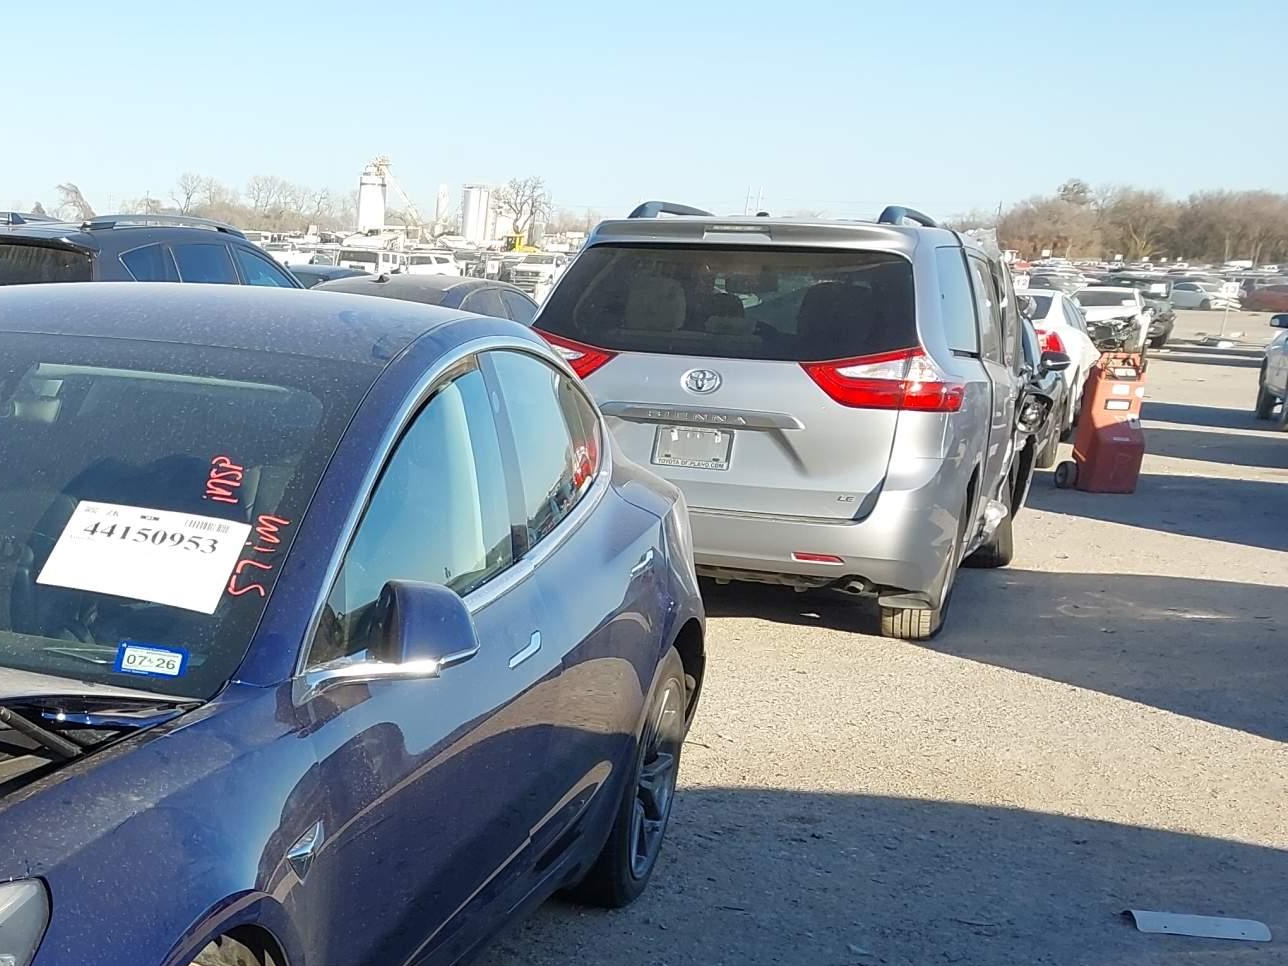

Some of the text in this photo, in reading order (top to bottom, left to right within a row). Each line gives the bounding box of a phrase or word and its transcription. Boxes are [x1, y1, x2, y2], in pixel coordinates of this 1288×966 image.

[837, 495, 855, 503] LE
[83, 521, 219, 555] 44150953
[126, 654, 148, 666] 07
[155, 658, 177, 670] 26
